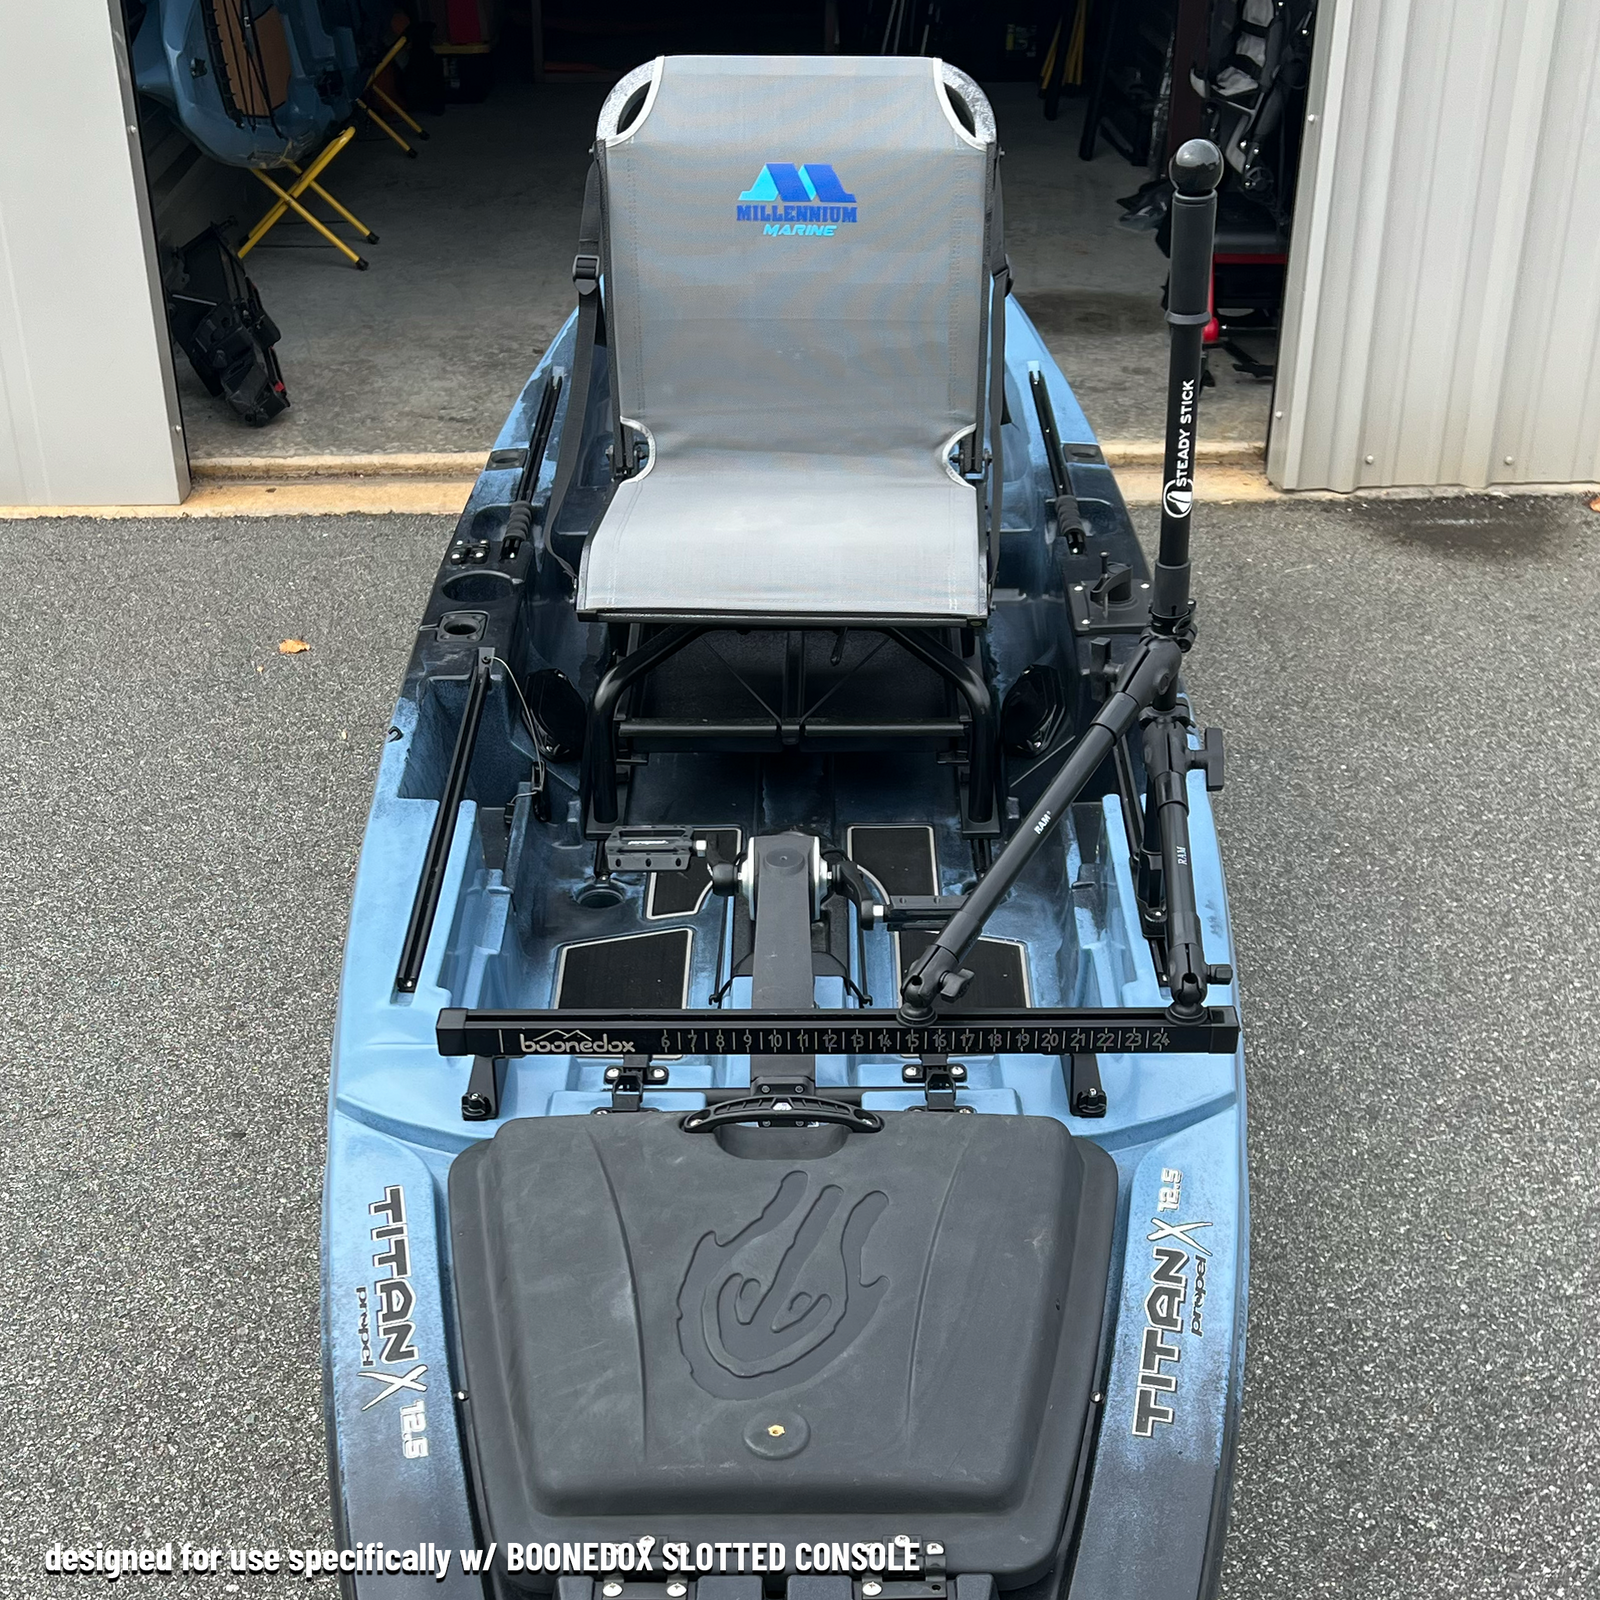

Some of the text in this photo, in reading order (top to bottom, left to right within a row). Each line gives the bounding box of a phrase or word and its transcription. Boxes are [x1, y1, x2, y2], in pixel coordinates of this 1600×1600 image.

[736, 205, 857, 223] MILLENNIUM
[763, 224, 837, 237] MARINE
[1176, 379, 1195, 487] STEADY STICK
[1177, 846, 1188, 865] RAM
[519, 1033, 635, 1052] boonedox
[661, 1033, 1170, 1048] 6 7 8 9 10 11 12 13 14 15 16 17 18 19 20 21 22 23 24
[1157, 1167, 1183, 1212] 12.5
[1191, 1255, 1213, 1337] propel
[356, 1286, 375, 1367] propel
[368, 1184, 419, 1365] TITAN
[400, 1399, 429, 1459] 12.5
[1131, 1246, 1190, 1438] TITAN
